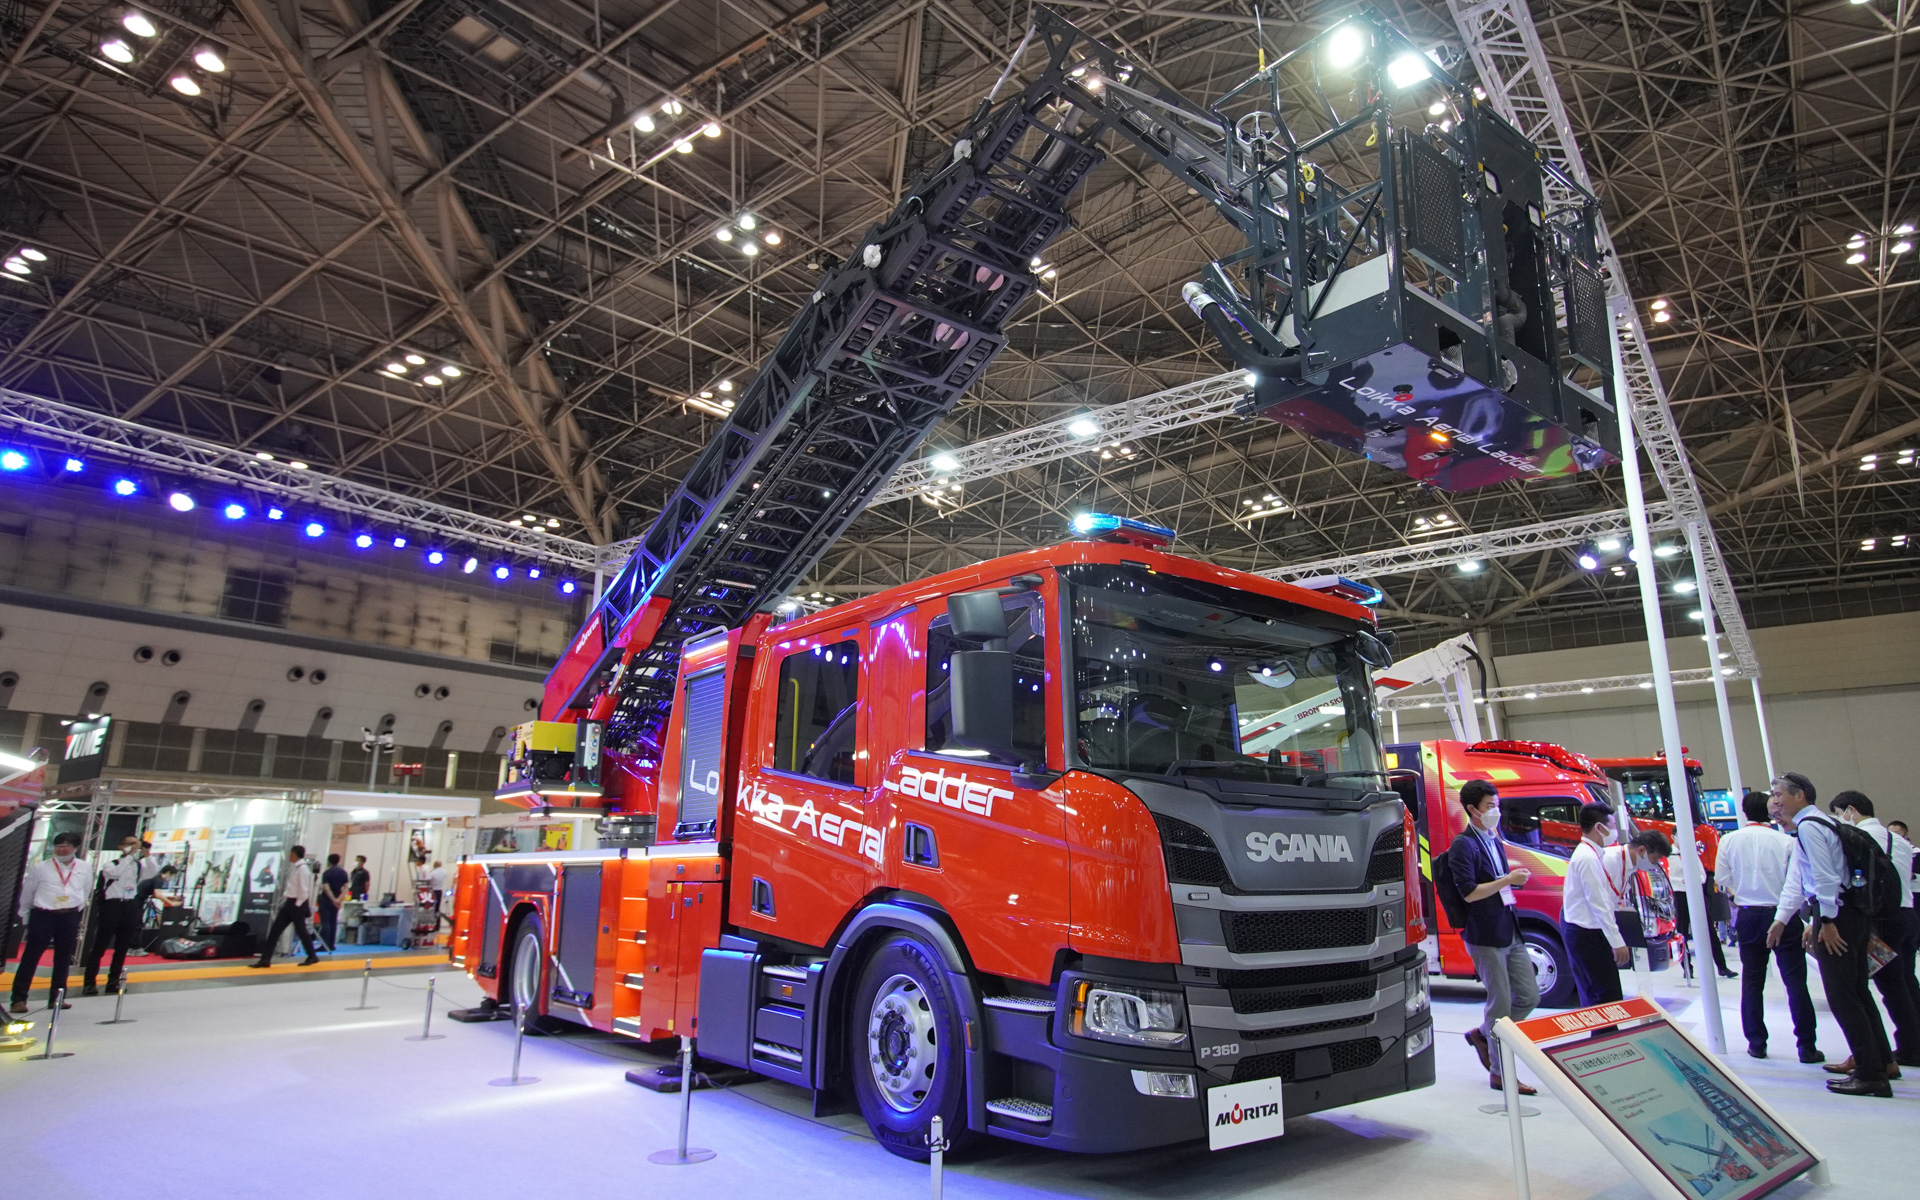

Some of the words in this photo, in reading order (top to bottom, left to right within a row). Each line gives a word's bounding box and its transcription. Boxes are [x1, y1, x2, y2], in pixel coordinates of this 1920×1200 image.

[1339, 376, 1417, 416] Loikka
[1415, 416, 1483, 445] Aerial
[1477, 442, 1544, 473] Ladder
[791, 799, 887, 864] Aerial
[882, 763, 1014, 818] Ladder
[1245, 831, 1355, 863] SCANIA
[1214, 1102, 1279, 1128] MORITA
